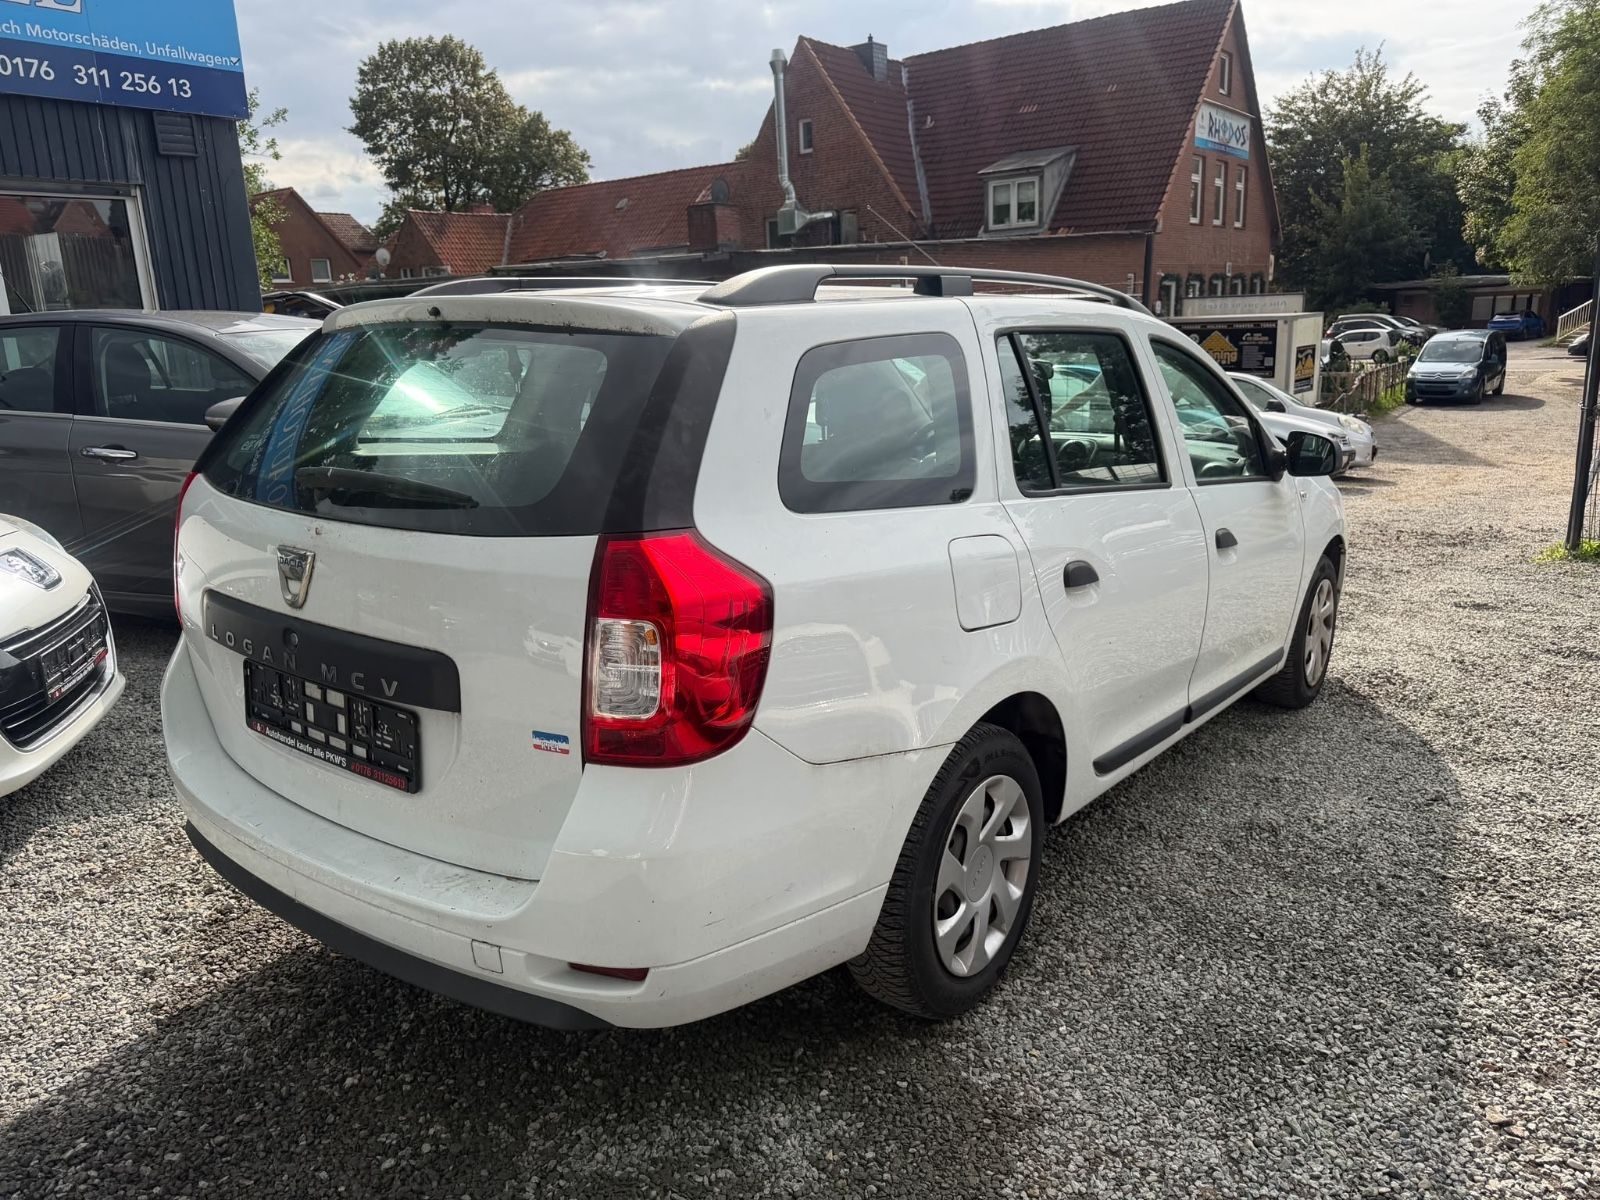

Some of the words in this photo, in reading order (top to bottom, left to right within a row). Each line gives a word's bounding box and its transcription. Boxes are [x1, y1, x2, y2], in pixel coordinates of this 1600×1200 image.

[0, 19, 20, 34] ch
[25, 22, 142, 55] Motorschäden,
[146, 41, 230, 67] Unfallwagen
[0, 54, 55, 81] 0176
[73, 64, 110, 88] 311
[119, 71, 161, 94] 256
[168, 78, 192, 98] 13
[280, 556, 303, 569] DACIA
[211, 624, 297, 671] LOGAN
[321, 663, 398, 697] MCV
[266, 726, 296, 747] Autohandel
[297, 740, 313, 754] kaufe
[314, 748, 325, 759] alle
[355, 764, 372, 777] 0176
[374, 769, 405, 789] 31125613
